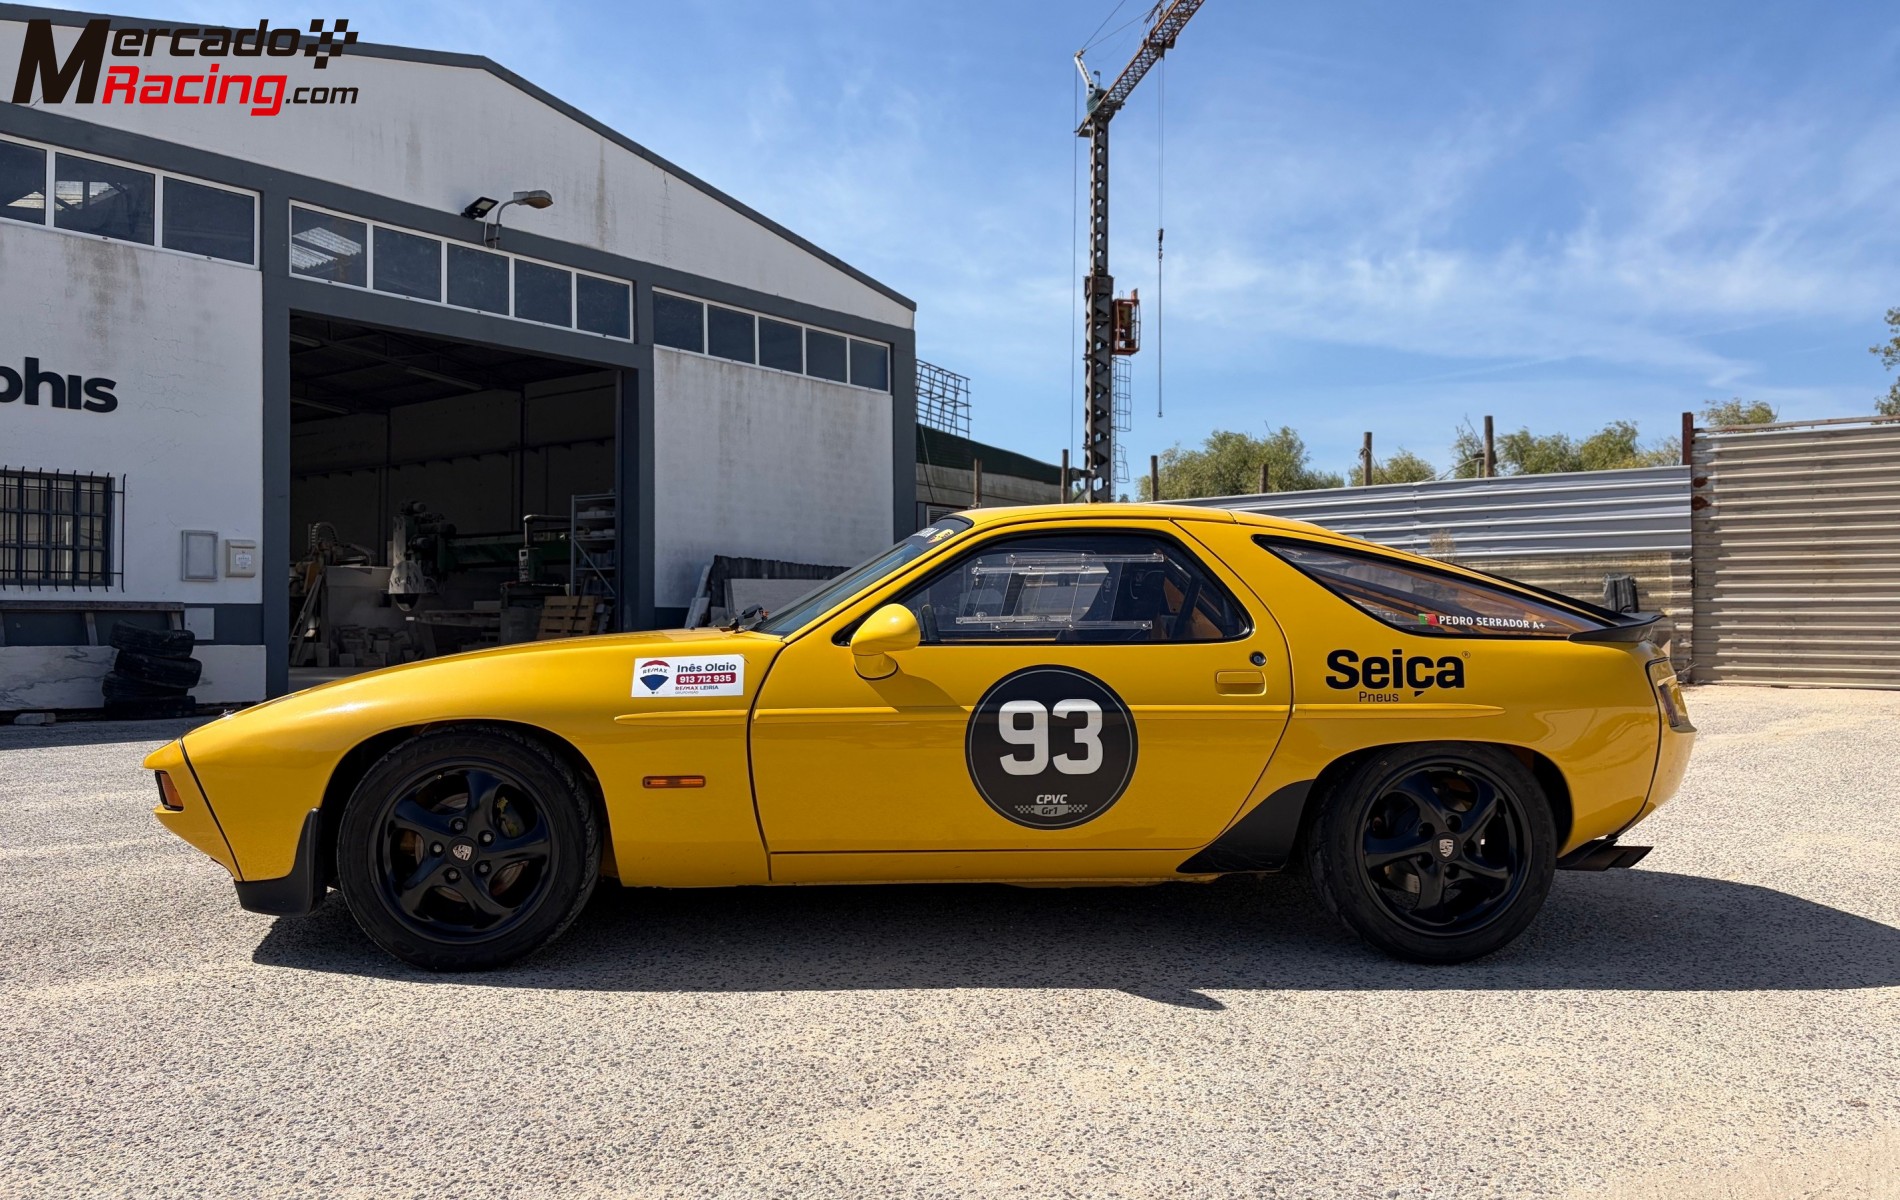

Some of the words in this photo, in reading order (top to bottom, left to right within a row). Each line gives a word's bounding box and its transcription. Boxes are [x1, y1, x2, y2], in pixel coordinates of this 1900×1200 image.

[1438, 615, 1474, 626] PEDRO
[1476, 616, 1530, 629] SERRADOR
[1532, 621, 1546, 629] A+
[677, 664, 702, 673] Inês
[705, 662, 737, 672] Olaio
[1325, 648, 1465, 698] Seiça
[679, 675, 695, 683] 913
[697, 675, 712, 683] 712
[713, 674, 732, 682] 935
[1358, 690, 1400, 703] Pneus
[998, 698, 1104, 776] 93
[1036, 794, 1068, 805] CPVC
[1041, 806, 1059, 815] Gr1
